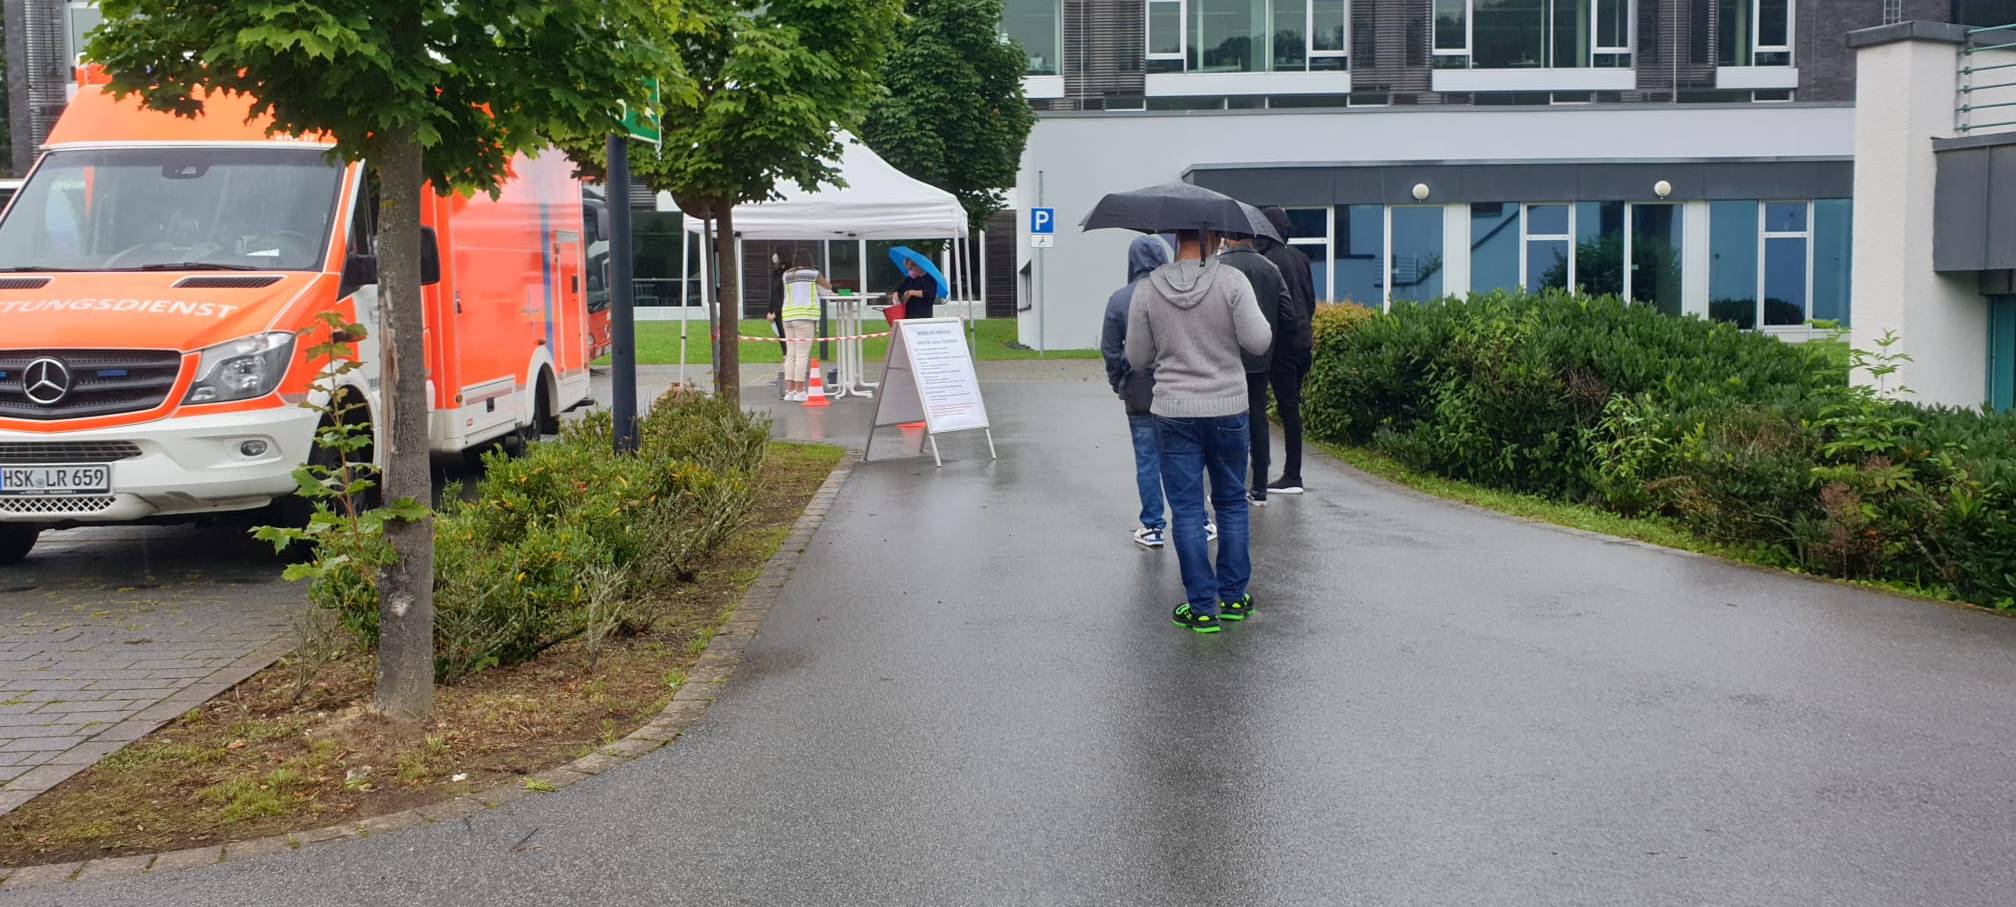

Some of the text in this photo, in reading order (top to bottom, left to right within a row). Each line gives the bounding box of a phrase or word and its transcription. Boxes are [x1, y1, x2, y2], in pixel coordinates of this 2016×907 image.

[1035, 210, 1050, 231] P
[0, 298, 238, 319] TUNGSDIENST
[3, 469, 104, 488] HSK LR 659
